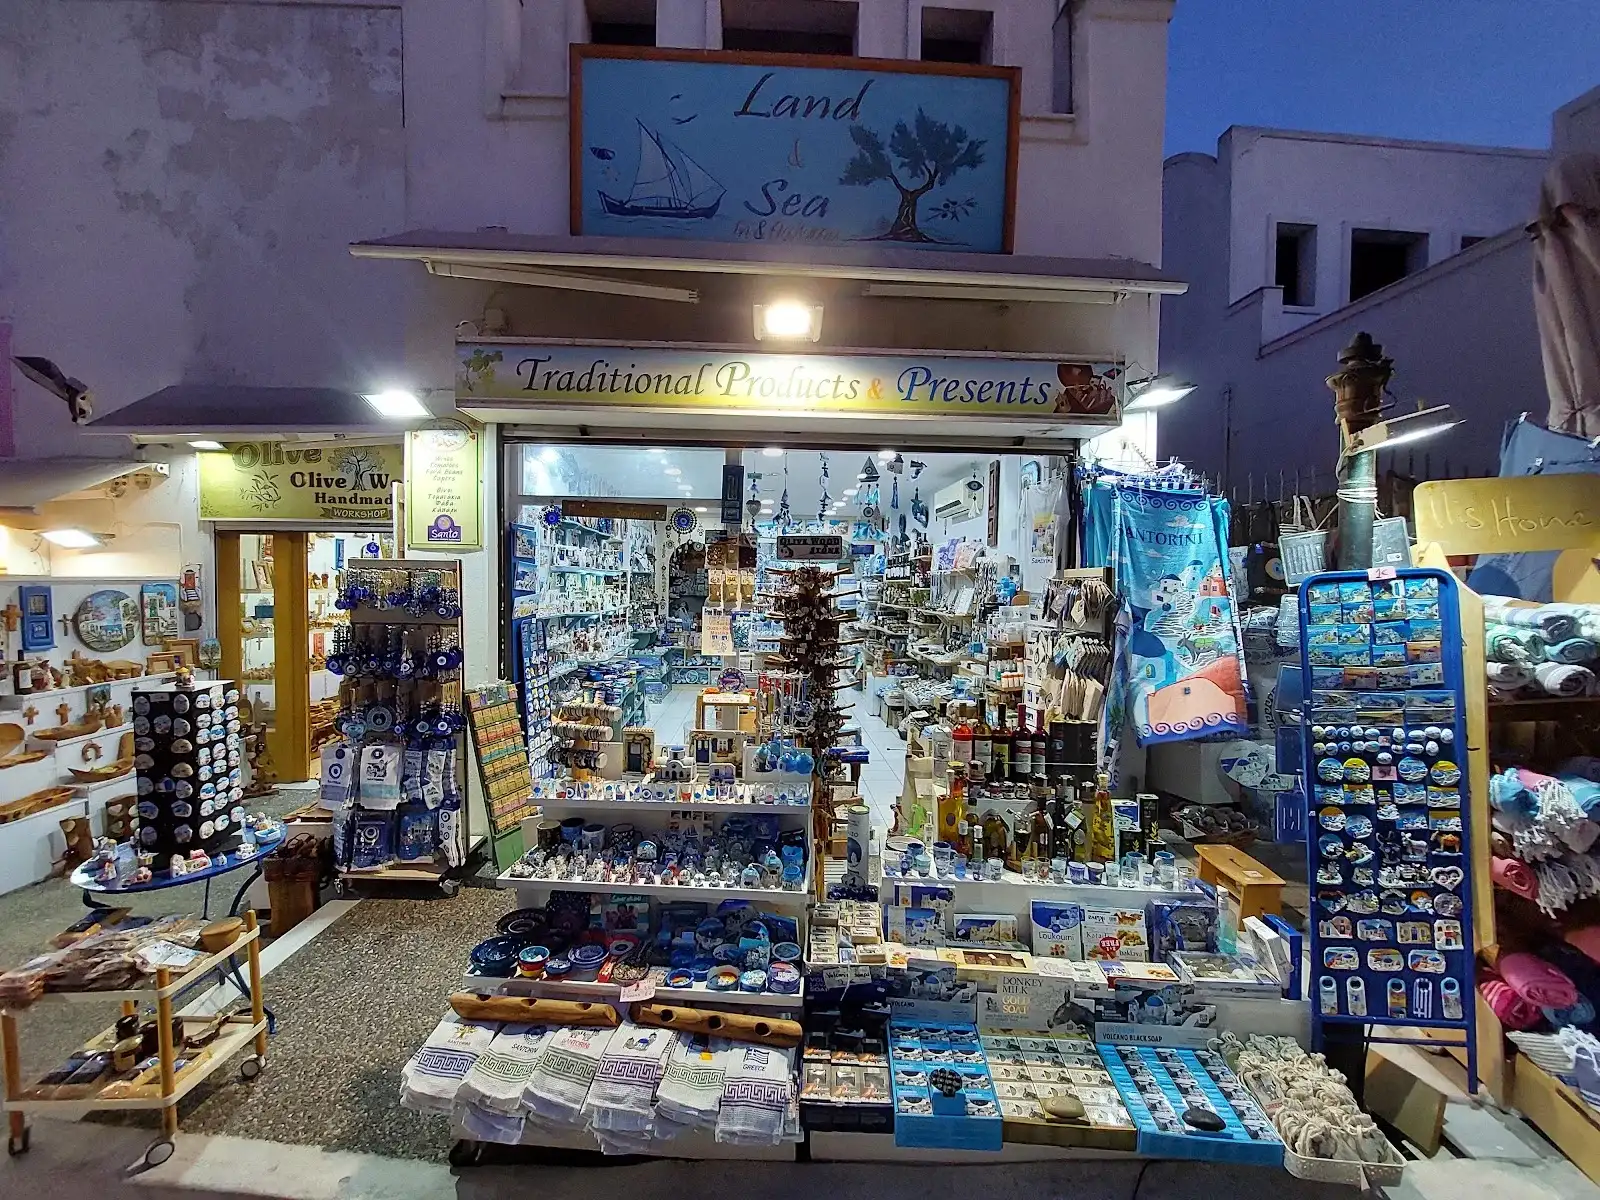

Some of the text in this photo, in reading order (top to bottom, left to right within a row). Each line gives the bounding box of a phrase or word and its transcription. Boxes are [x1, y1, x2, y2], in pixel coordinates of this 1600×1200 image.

[733, 72, 875, 121] Land
[743, 179, 830, 218] Sea
[516, 356, 1052, 405] Traditional Products & Presents
[232, 441, 322, 468] Olive
[290, 471, 348, 489] Olive
[333, 509, 386, 518] WORKSHOP
[1491, 496, 1592, 537] Home
[431, 528, 459, 539] Santo
[1038, 931, 1075, 941] Loukoumi
[1002, 977, 1045, 988] DONKEY
[1002, 985, 1028, 995] MILK
[1002, 995, 1030, 1004] GOLD
[1002, 1004, 1030, 1014] SOAP
[1102, 1033, 1129, 1041] VOLCANO
[742, 1064, 766, 1072] GREECE
